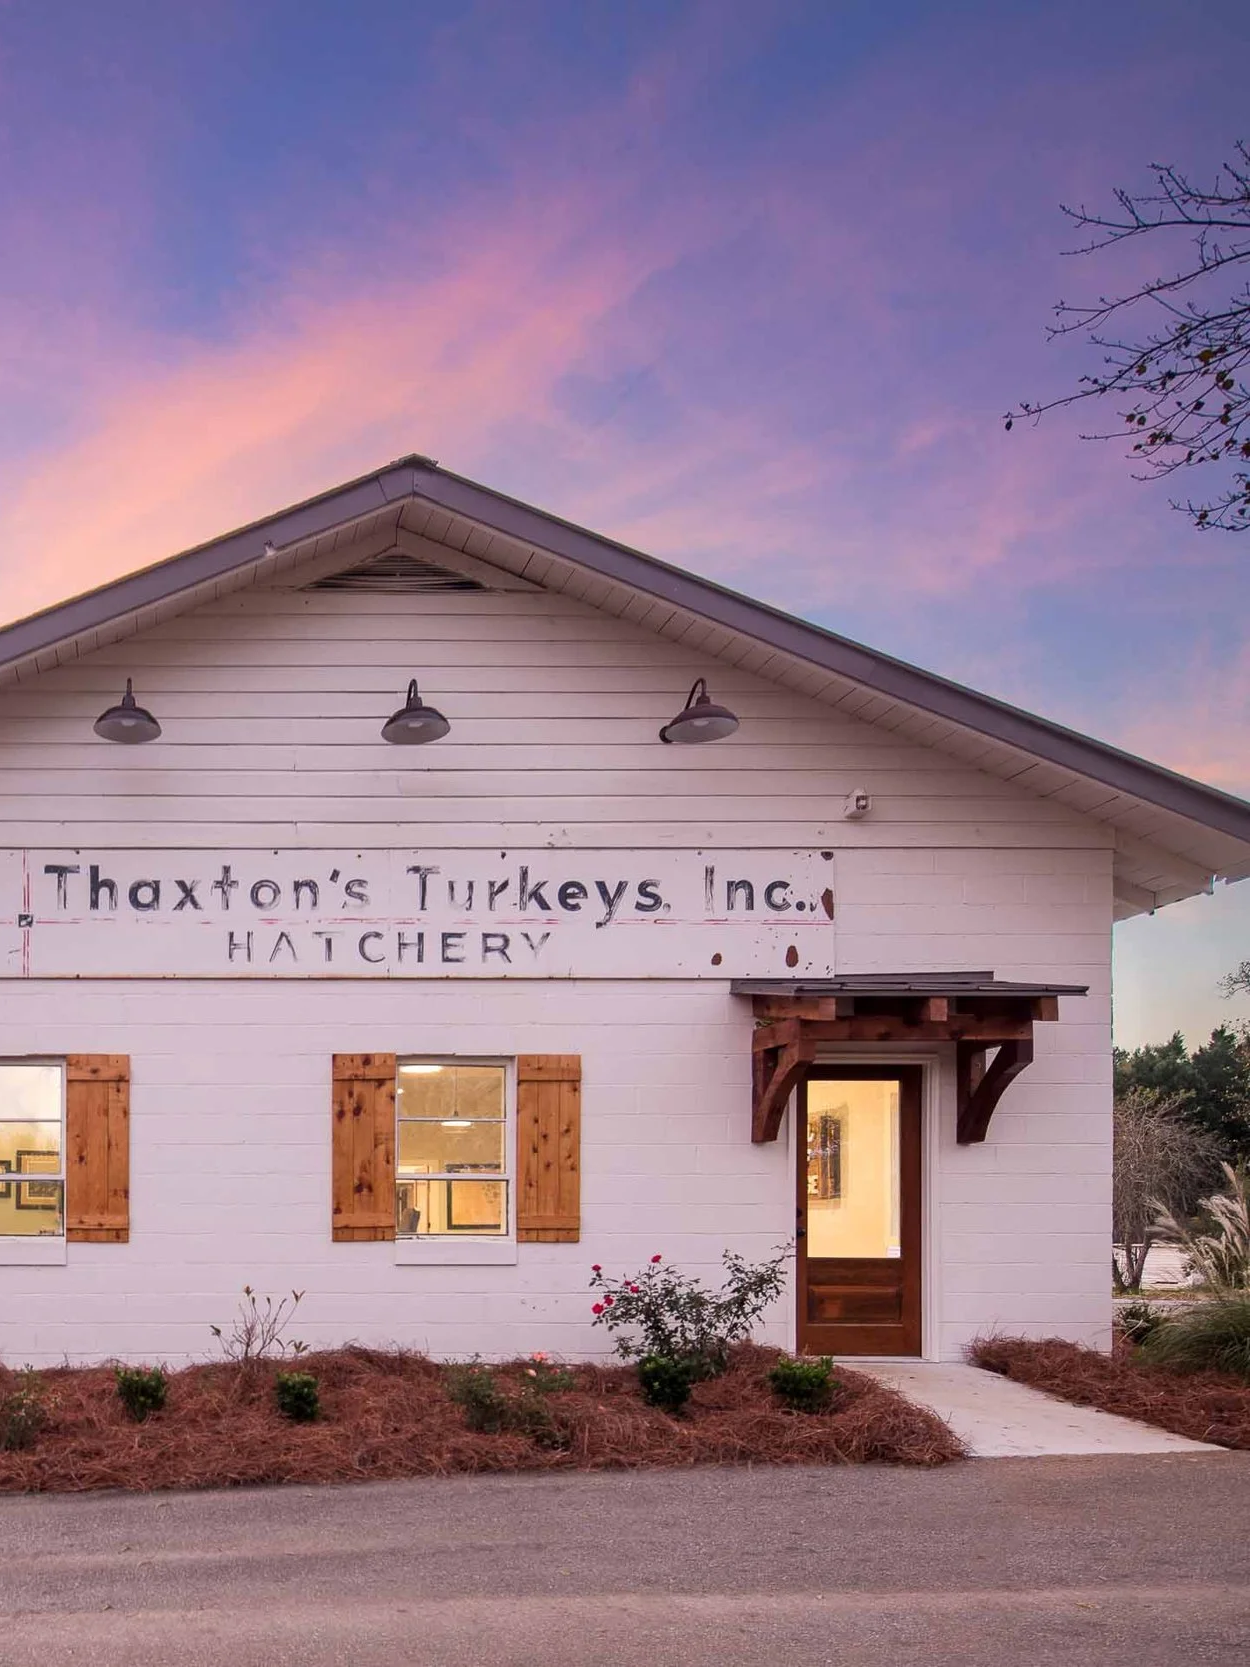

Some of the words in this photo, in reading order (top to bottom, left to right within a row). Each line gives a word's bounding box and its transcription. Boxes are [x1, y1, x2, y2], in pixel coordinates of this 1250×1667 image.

[44, 864, 371, 911] Thaxton's
[704, 865, 806, 913] Inc.
[229, 930, 551, 963] HATCHERY
